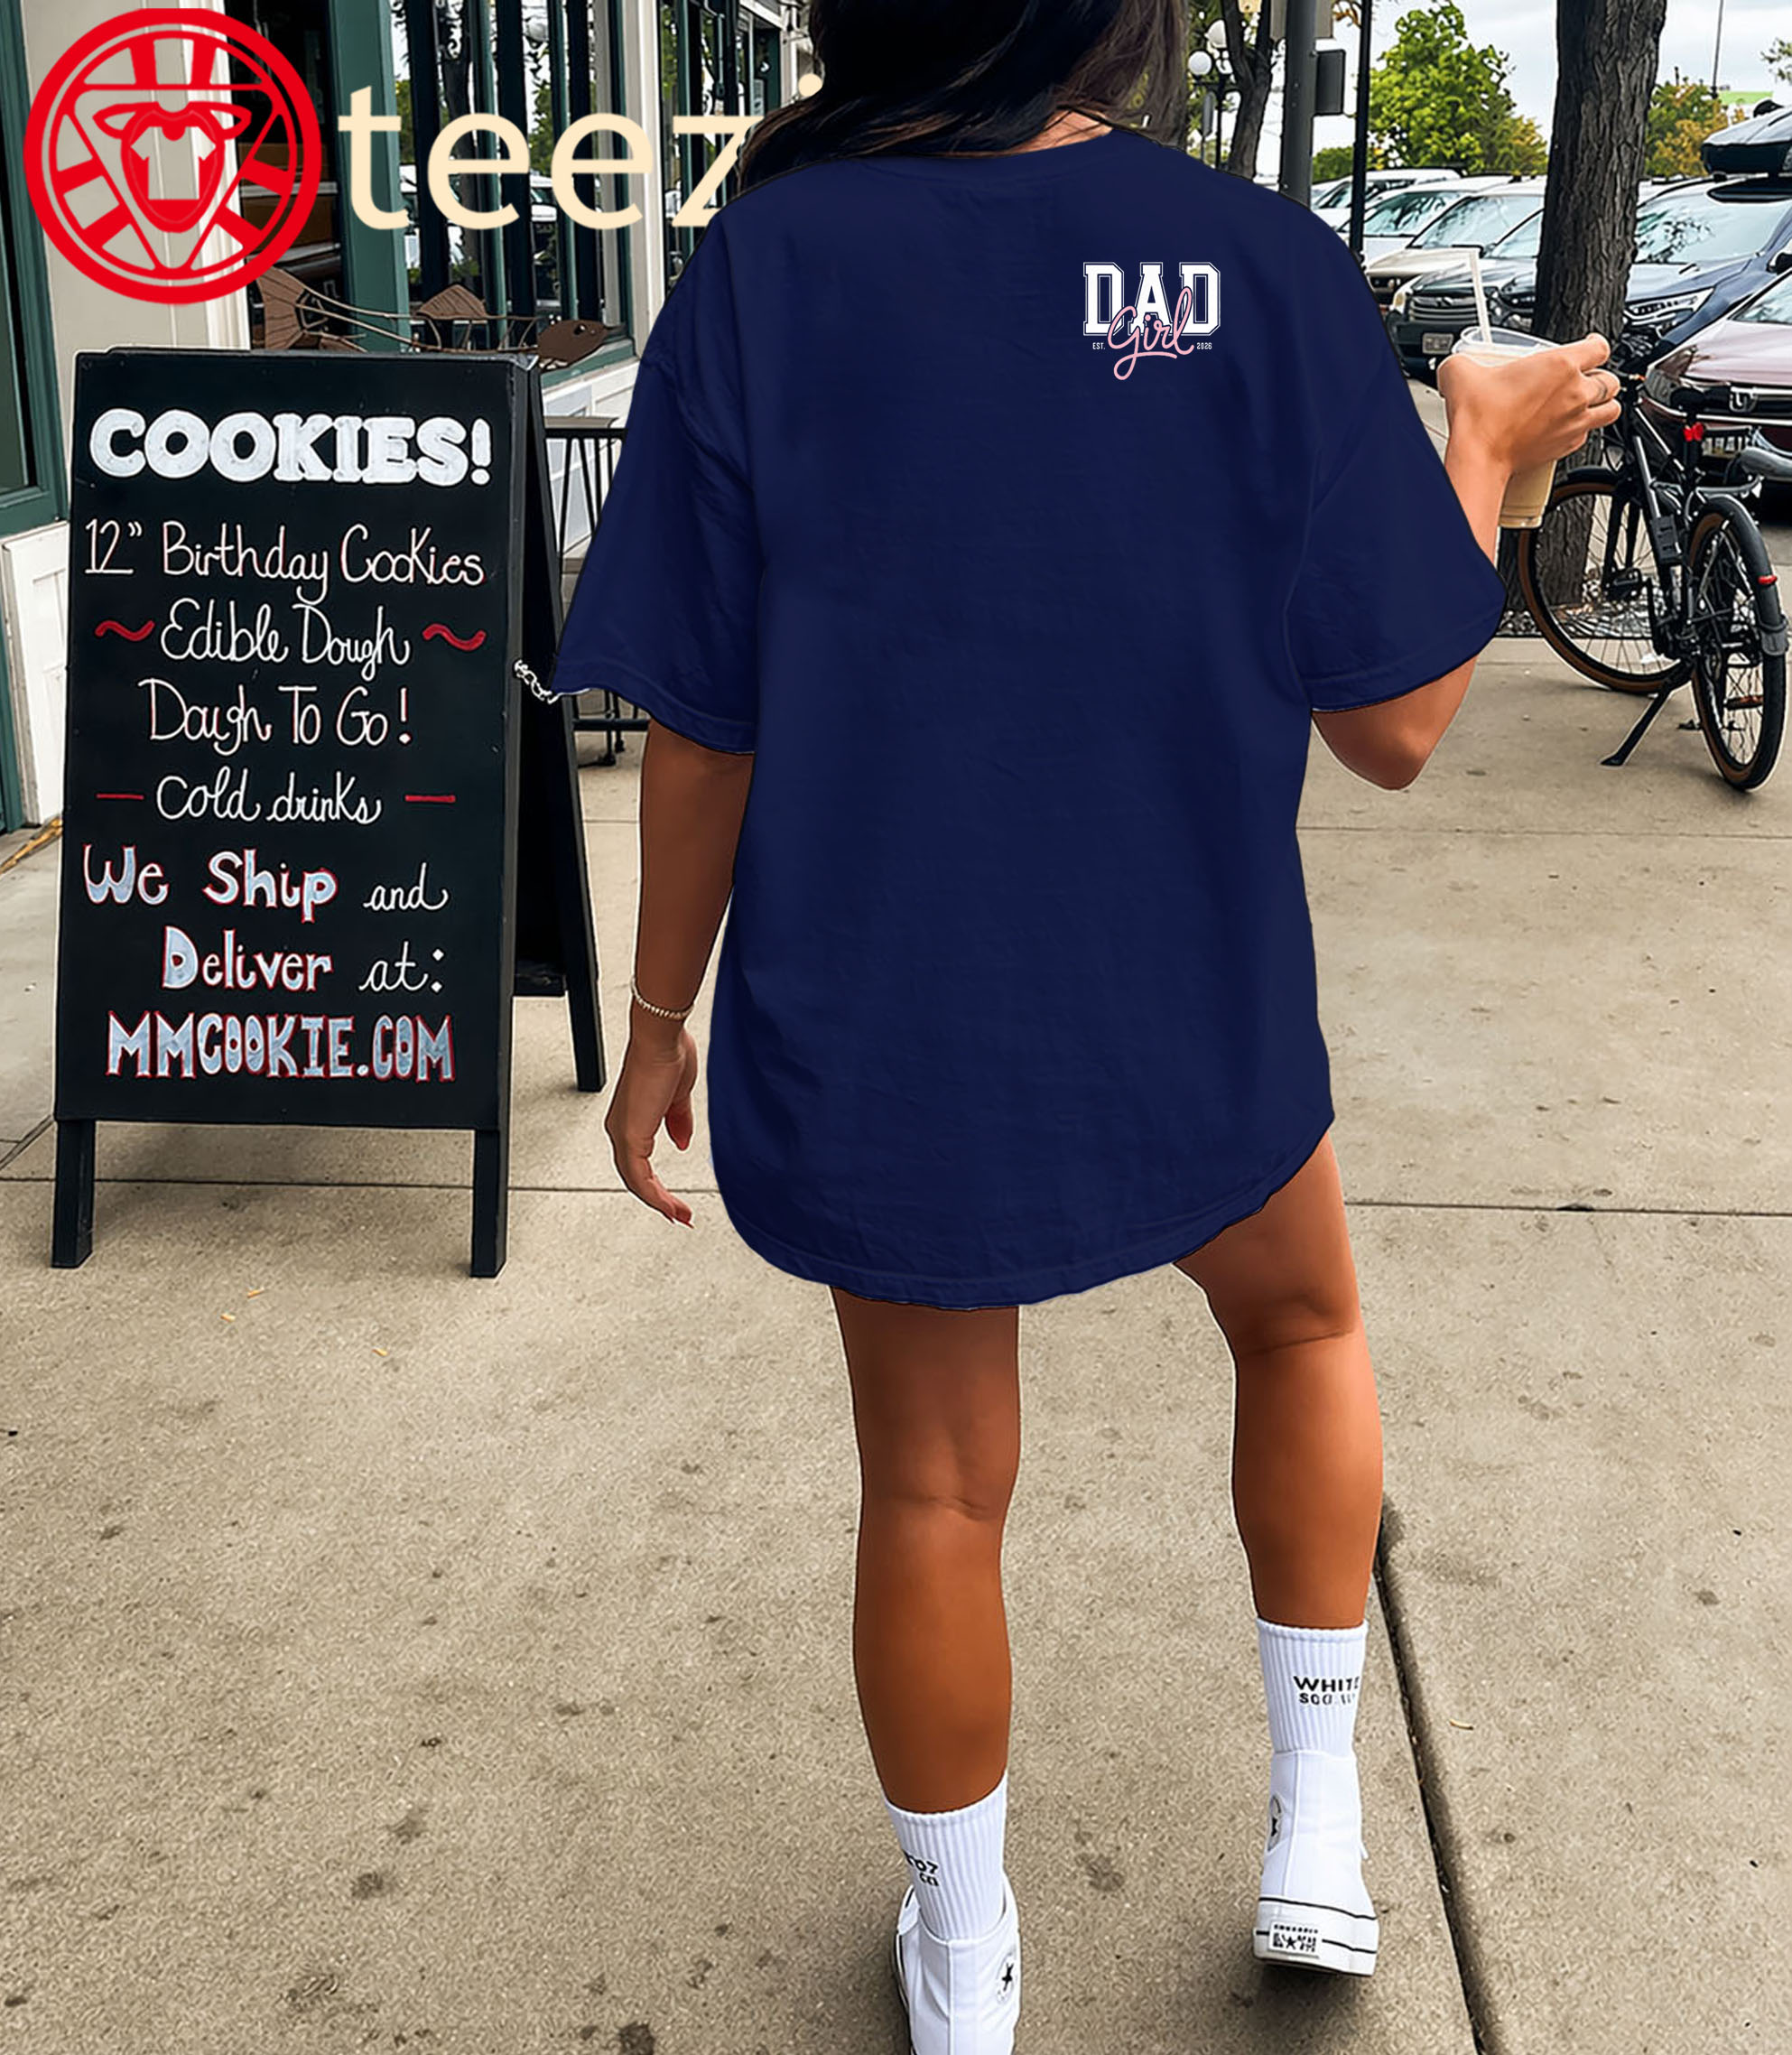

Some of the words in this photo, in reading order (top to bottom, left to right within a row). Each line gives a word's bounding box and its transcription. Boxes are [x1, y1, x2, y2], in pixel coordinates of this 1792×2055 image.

[1083, 262, 1221, 336] DAD
[1108, 287, 1194, 380] Girl
[1092, 342, 1106, 350] EST.
[1196, 342, 1212, 350] 2026
[90, 408, 492, 487] COOKIES!
[162, 521, 329, 604] Birthday
[161, 598, 289, 661] Edible
[292, 603, 411, 681] Dough
[278, 685, 321, 744] To
[156, 766, 261, 822] Cold
[83, 844, 169, 905] We
[203, 848, 339, 922] Ship
[363, 862, 449, 911] and
[162, 925, 333, 991] Deliver
[358, 942, 444, 992] at:
[105, 1010, 456, 1083] MMCOOKIE.COM
